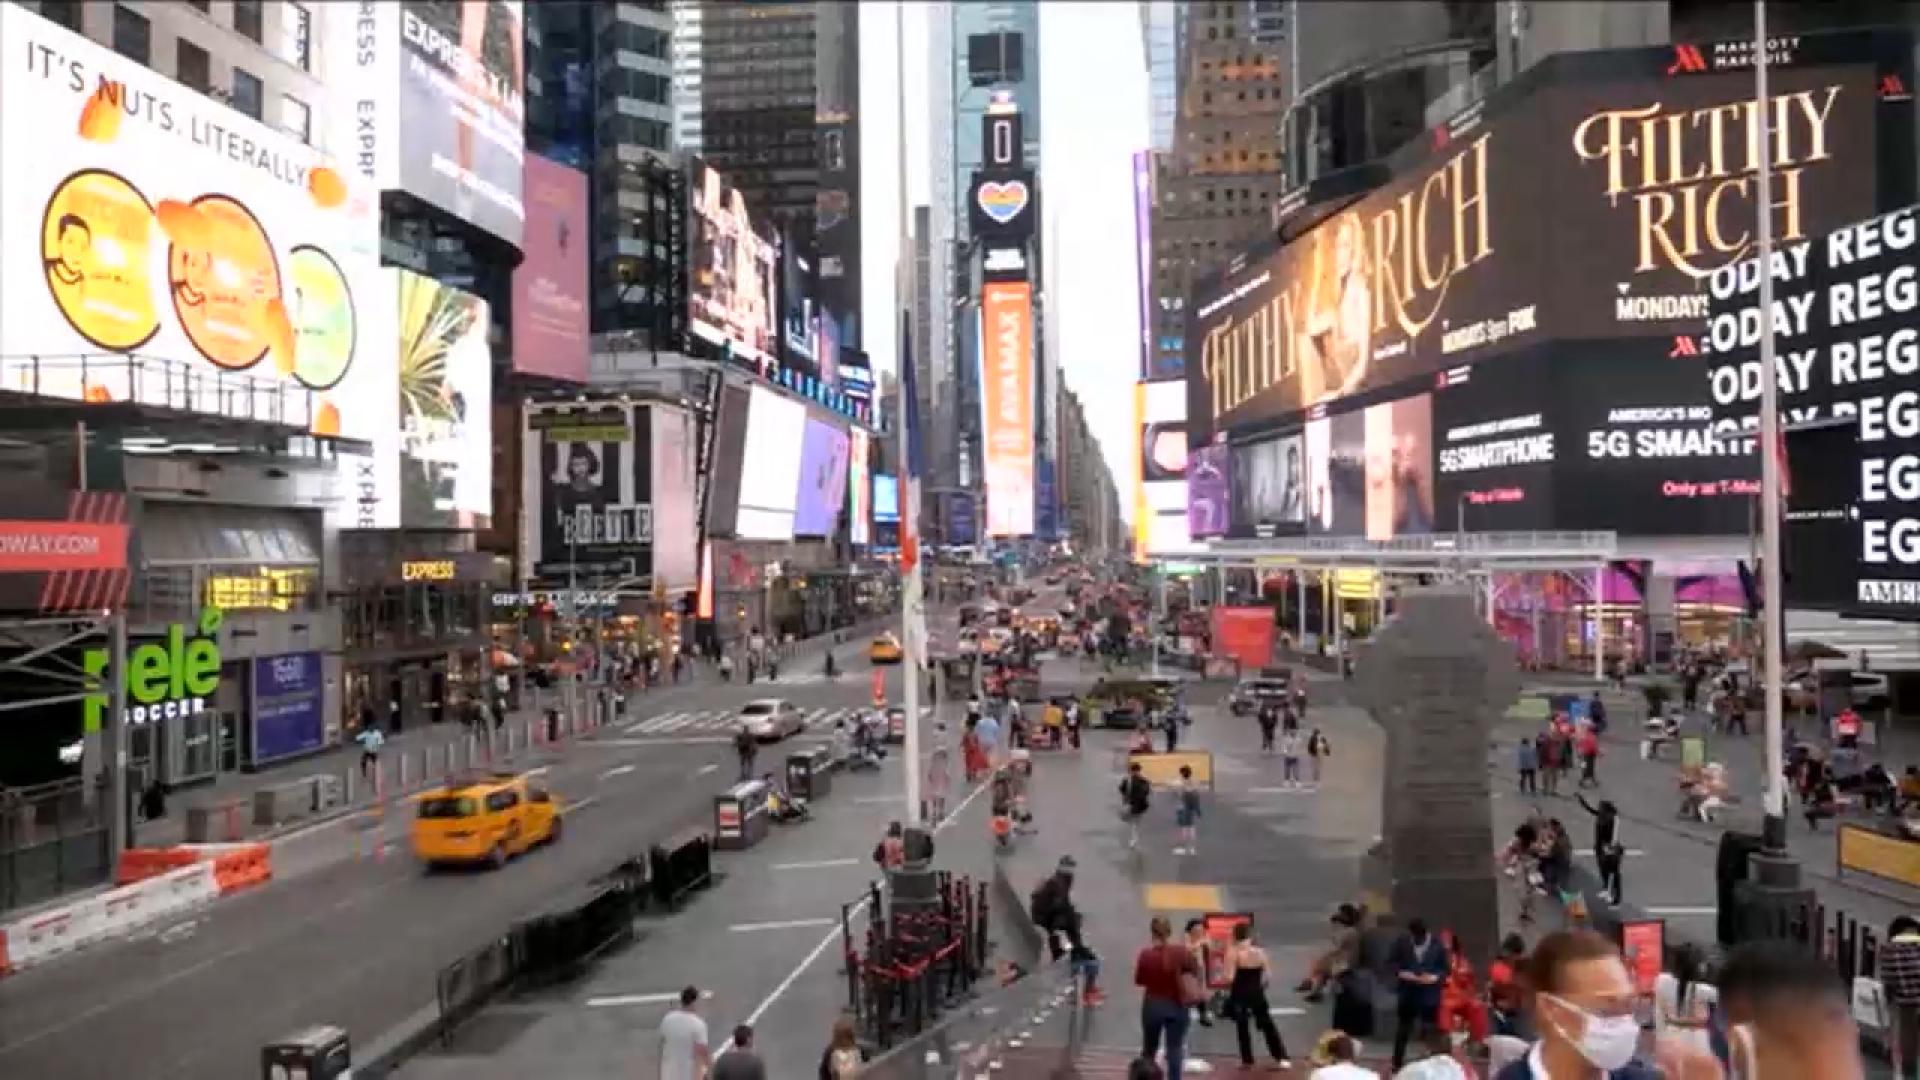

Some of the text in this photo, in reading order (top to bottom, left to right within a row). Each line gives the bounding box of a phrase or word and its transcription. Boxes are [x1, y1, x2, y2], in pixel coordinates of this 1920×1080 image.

[1715, 37, 1800, 54] MARROTT
[27, 40, 85, 92] IT'S
[190, 115, 305, 187] LITERALLY
[1573, 84, 1843, 207] FILTHY
[1372, 132, 1495, 342] RICH
[1632, 167, 1806, 282] RICH
[1710, 210, 1916, 299] ODAY REG
[1707, 266, 1918, 352] ODAY REG
[1707, 329, 1919, 404] ODAY REG
[1588, 430, 1630, 458] 5G
[402, 560, 455, 581] EXPRESS
